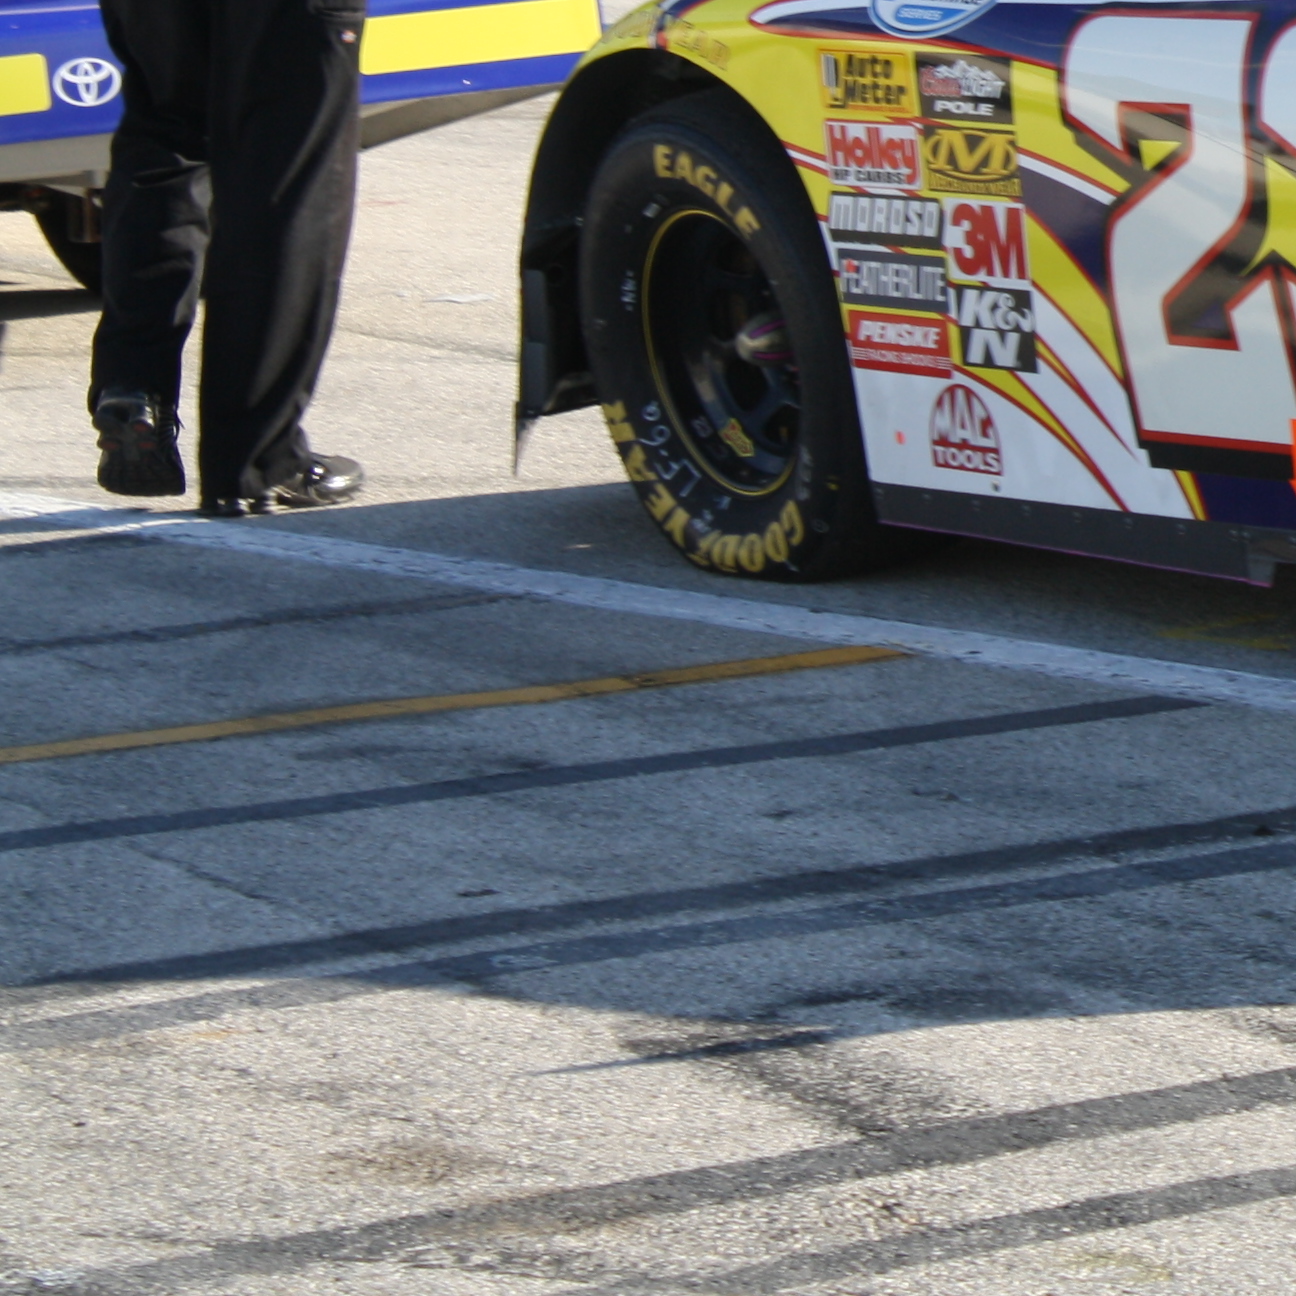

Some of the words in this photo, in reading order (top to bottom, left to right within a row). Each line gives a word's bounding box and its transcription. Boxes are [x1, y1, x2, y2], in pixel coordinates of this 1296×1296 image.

[844, 54, 893, 80] Auto
[842, 79, 907, 106] Meter
[933, 99, 995, 117] POLE
[827, 124, 918, 186] Holley
[652, 143, 762, 240] EAGLE
[830, 194, 940, 238] MOROSO
[952, 202, 1028, 281] 3M
[857, 319, 942, 349] PENSKE
[930, 387, 1000, 449] MAC
[933, 445, 1003, 473] TOOLS
